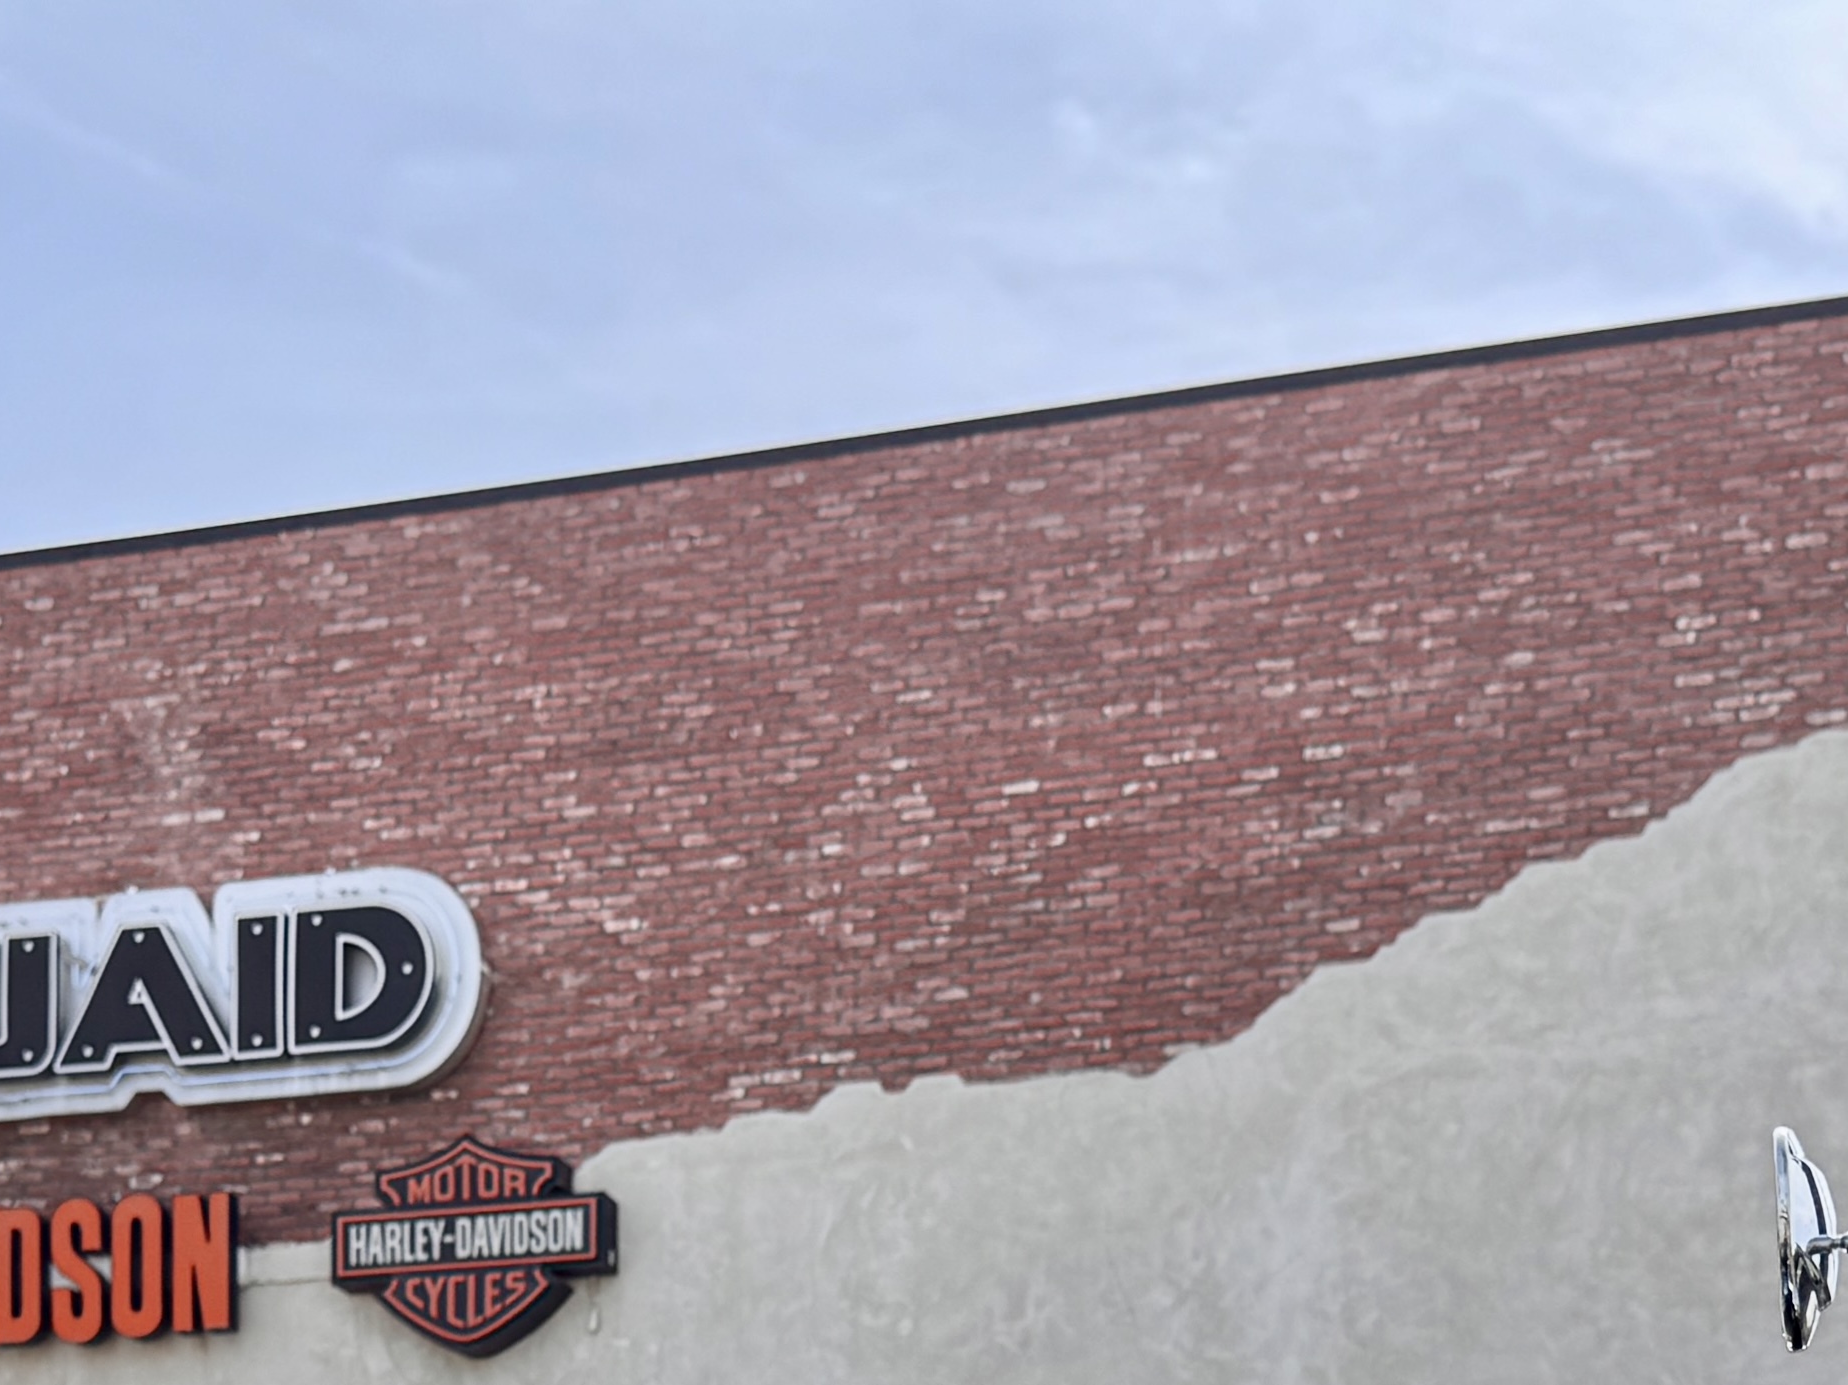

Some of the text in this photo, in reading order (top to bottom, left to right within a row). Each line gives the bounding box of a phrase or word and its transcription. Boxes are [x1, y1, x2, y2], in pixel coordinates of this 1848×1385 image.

[407, 1154, 527, 1205] MOTOR
[347, 1207, 584, 1267] HARLEY-DAVIDSON
[405, 1269, 527, 1329] CYCLES
